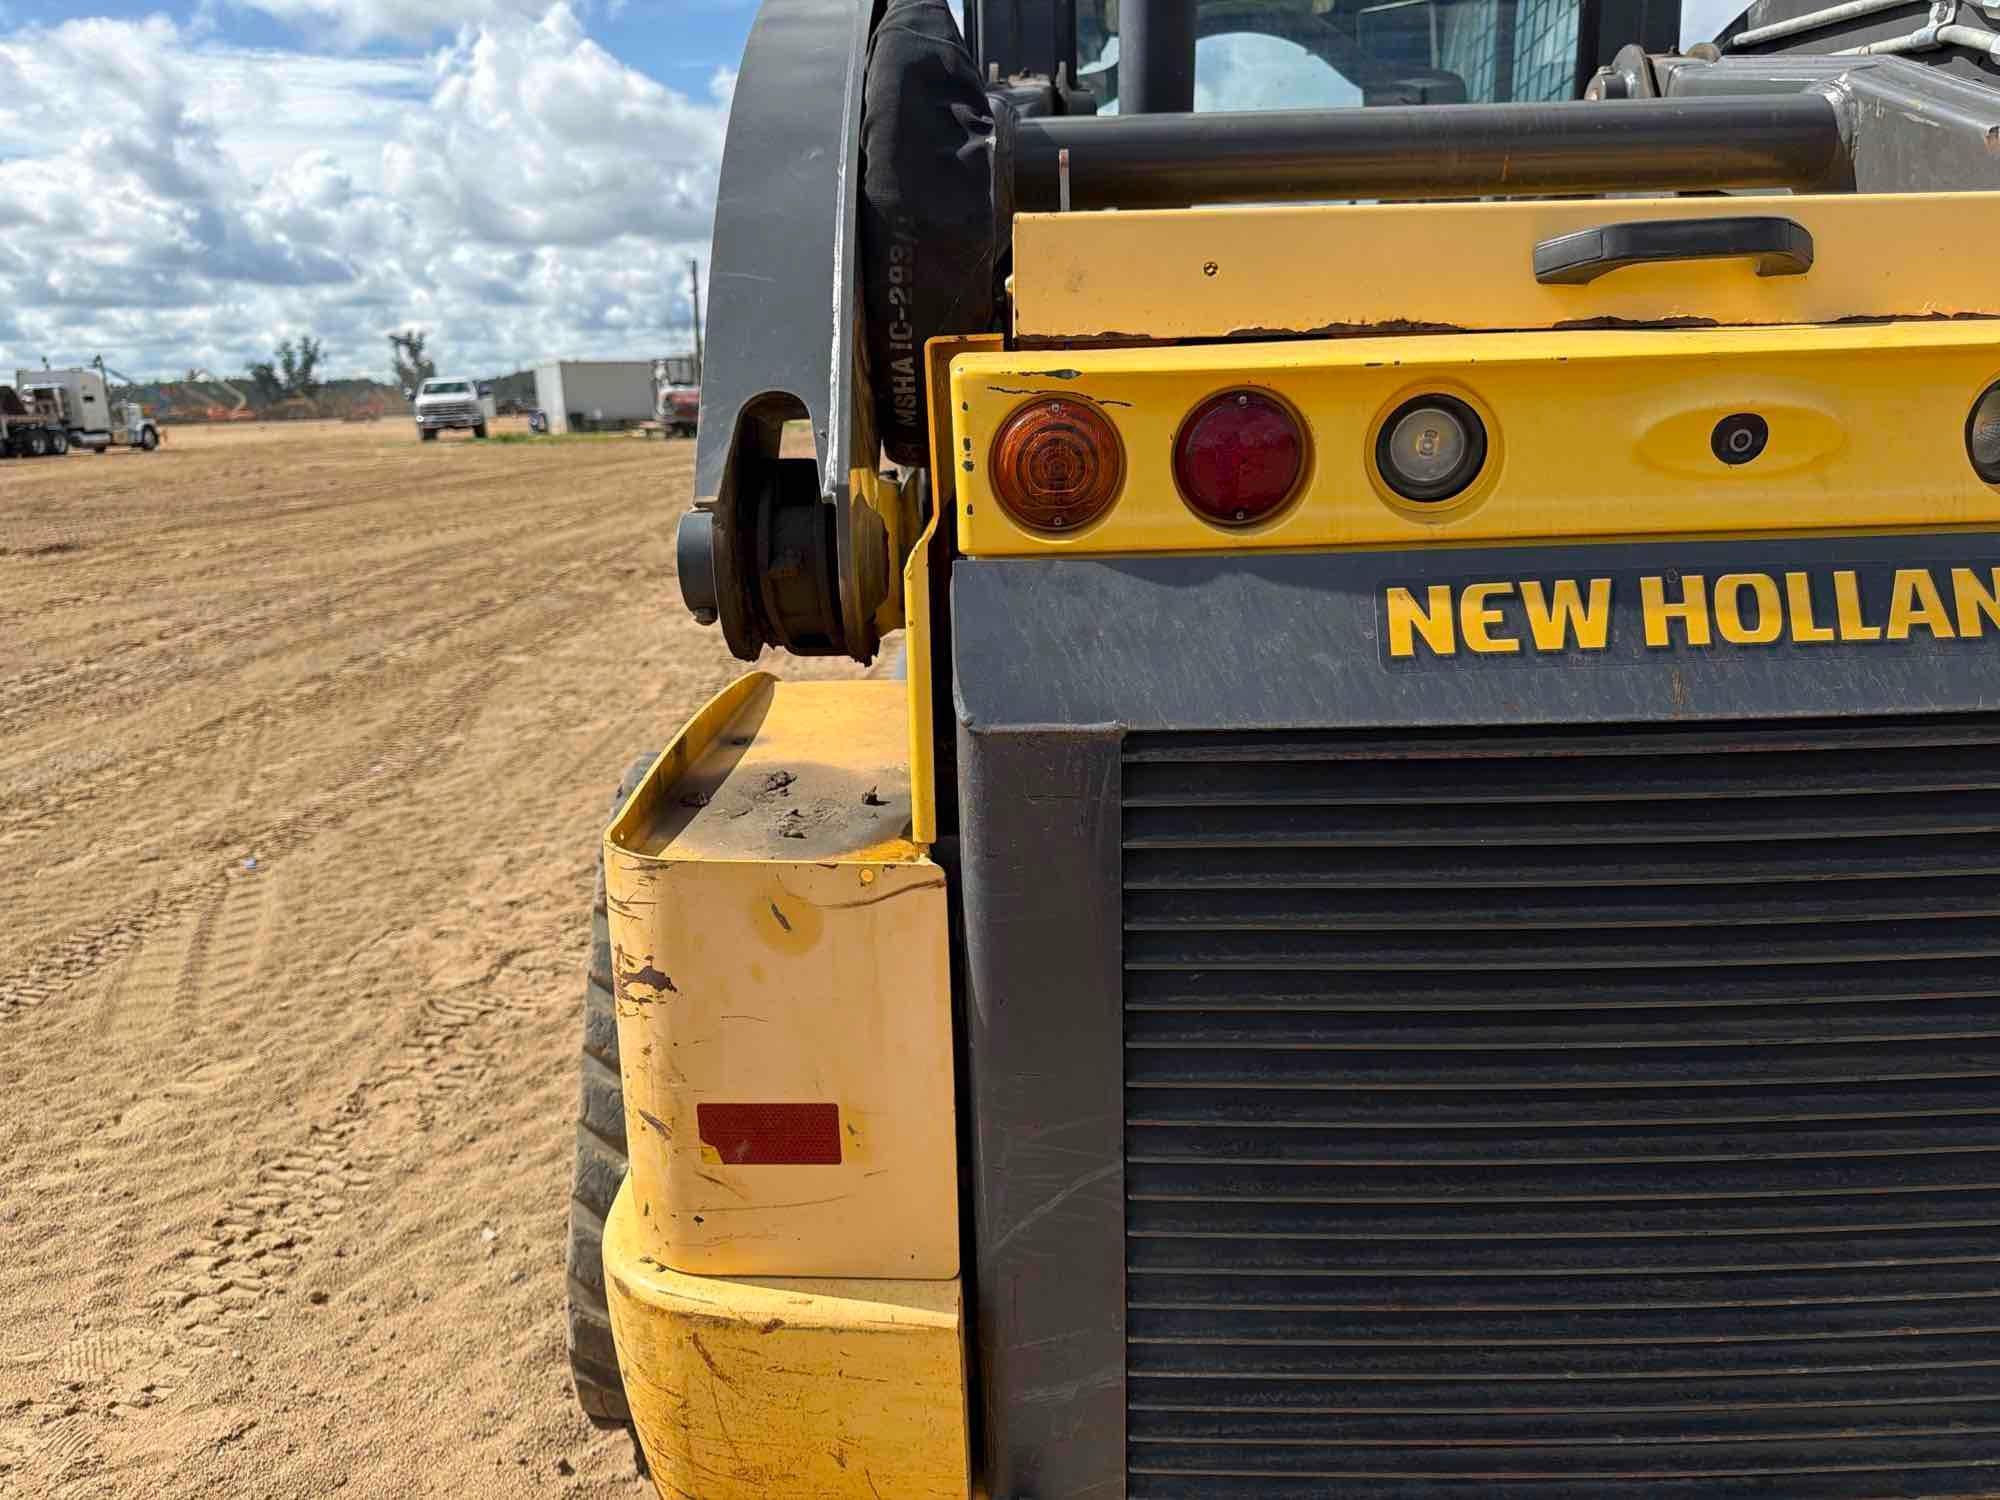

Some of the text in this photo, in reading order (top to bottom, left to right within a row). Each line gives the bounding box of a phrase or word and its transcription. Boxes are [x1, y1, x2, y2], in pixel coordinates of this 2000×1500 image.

[889, 356, 917, 427] MSHA
[1386, 567, 2000, 657] NEW HOLLAN
